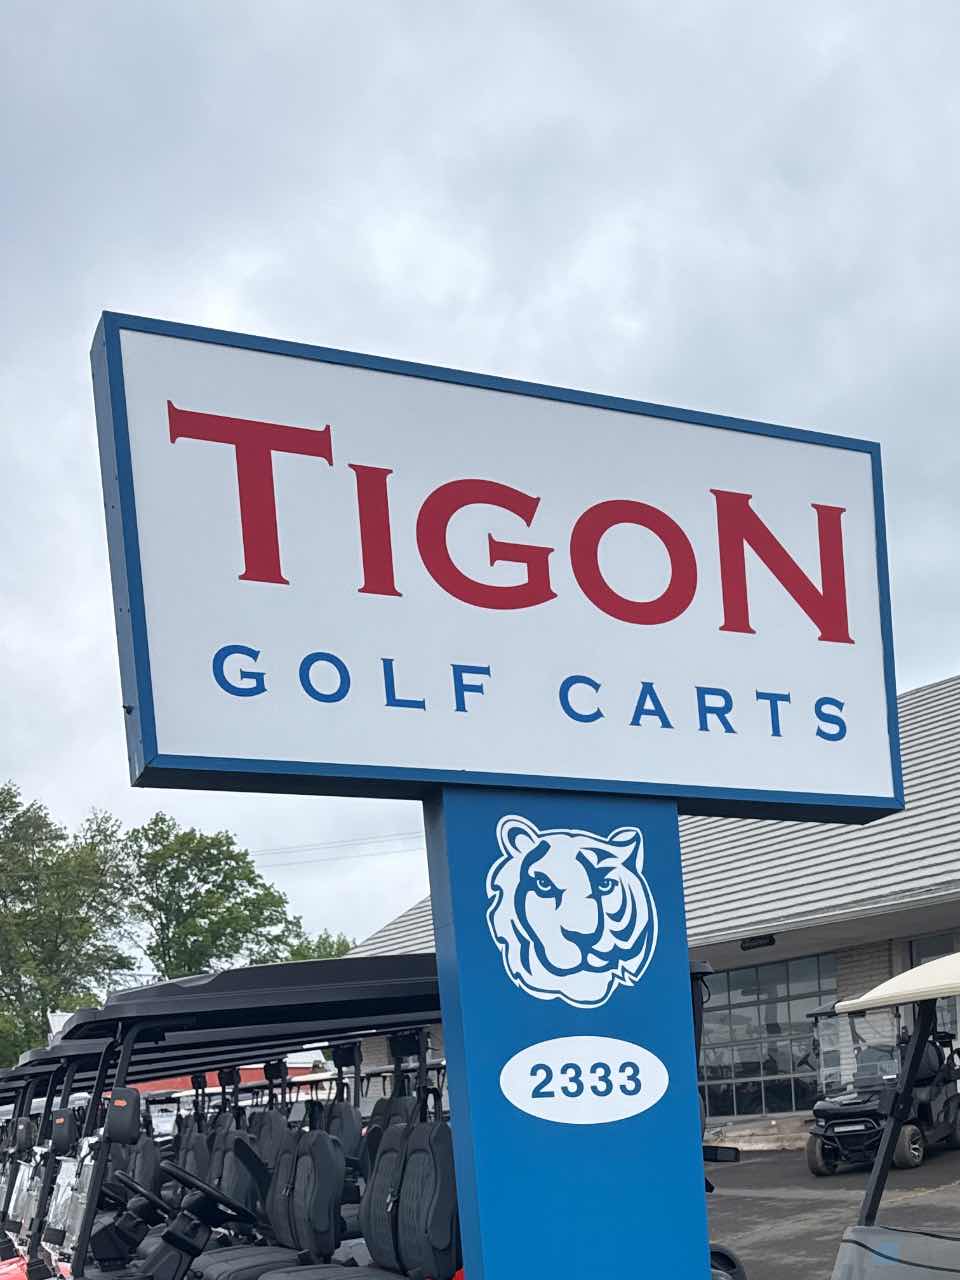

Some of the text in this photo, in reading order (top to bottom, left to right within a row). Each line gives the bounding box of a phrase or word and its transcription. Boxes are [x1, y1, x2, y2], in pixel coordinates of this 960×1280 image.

[167, 400, 855, 644] TIGON
[212, 644, 848, 742] GOLF CARTS
[530, 1061, 642, 1099] 2333
